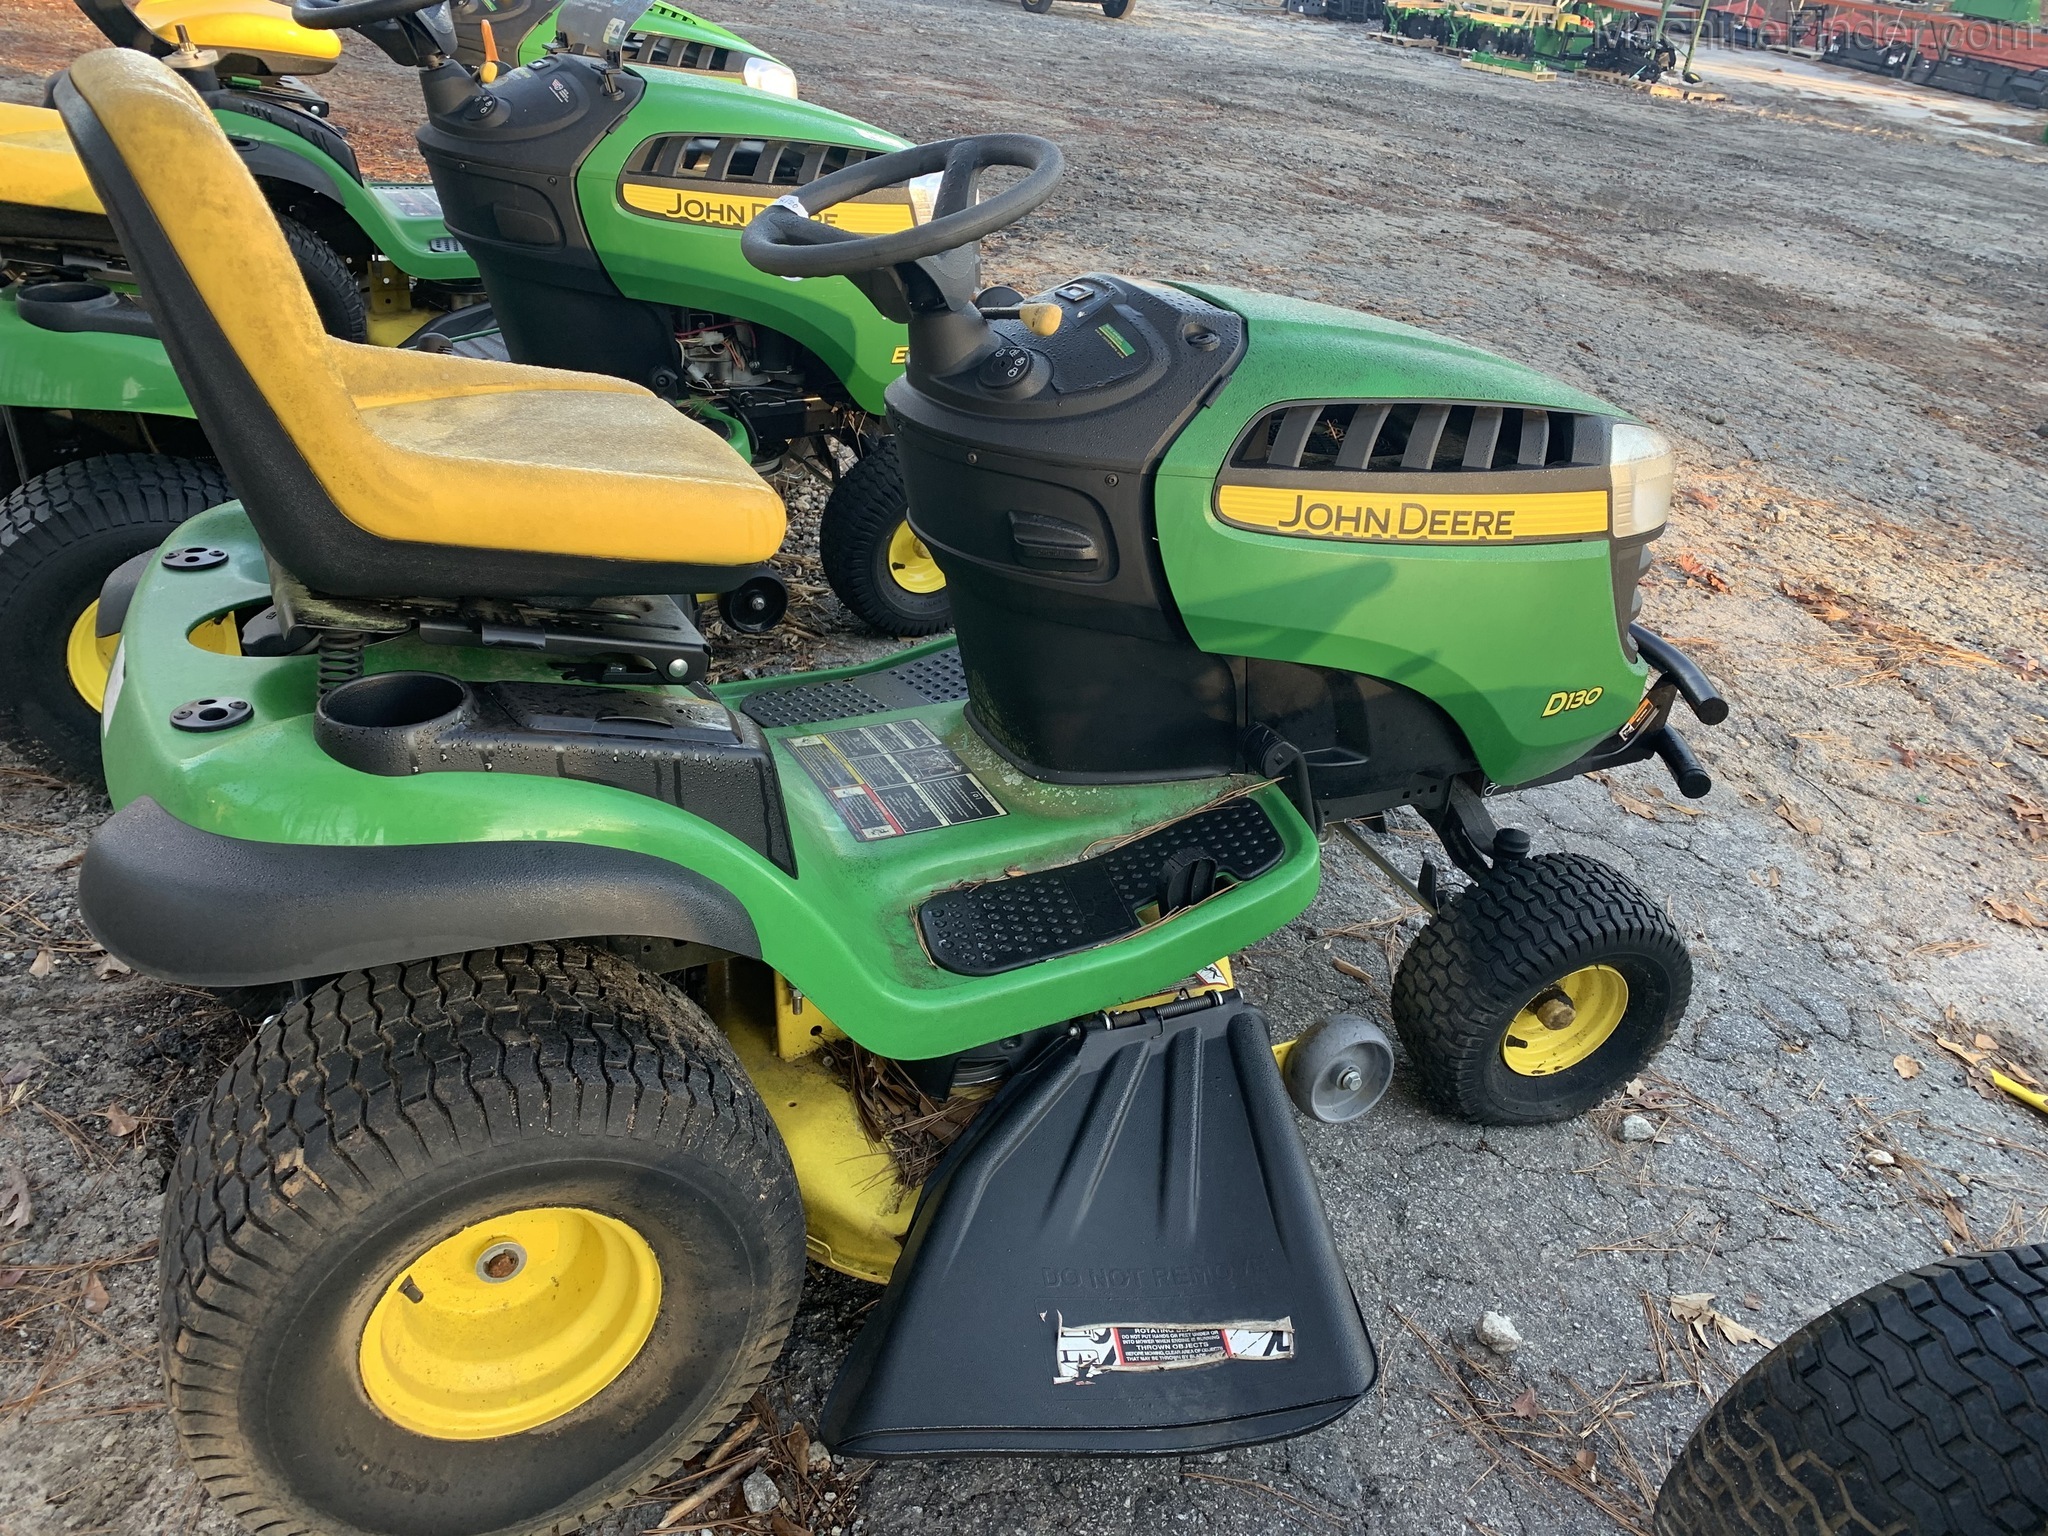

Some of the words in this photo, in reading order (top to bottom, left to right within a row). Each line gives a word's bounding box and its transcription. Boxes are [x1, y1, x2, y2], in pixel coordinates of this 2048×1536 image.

[666, 193, 745, 224] JOHN
[1278, 494, 1391, 534] JOHN
[1398, 502, 1516, 536] DEERE
[1541, 685, 1604, 719] D130
[1041, 1266, 1083, 1288] DO
[1088, 1266, 1145, 1289] NOT
[1172, 1342, 1209, 1350] OBJECTS
